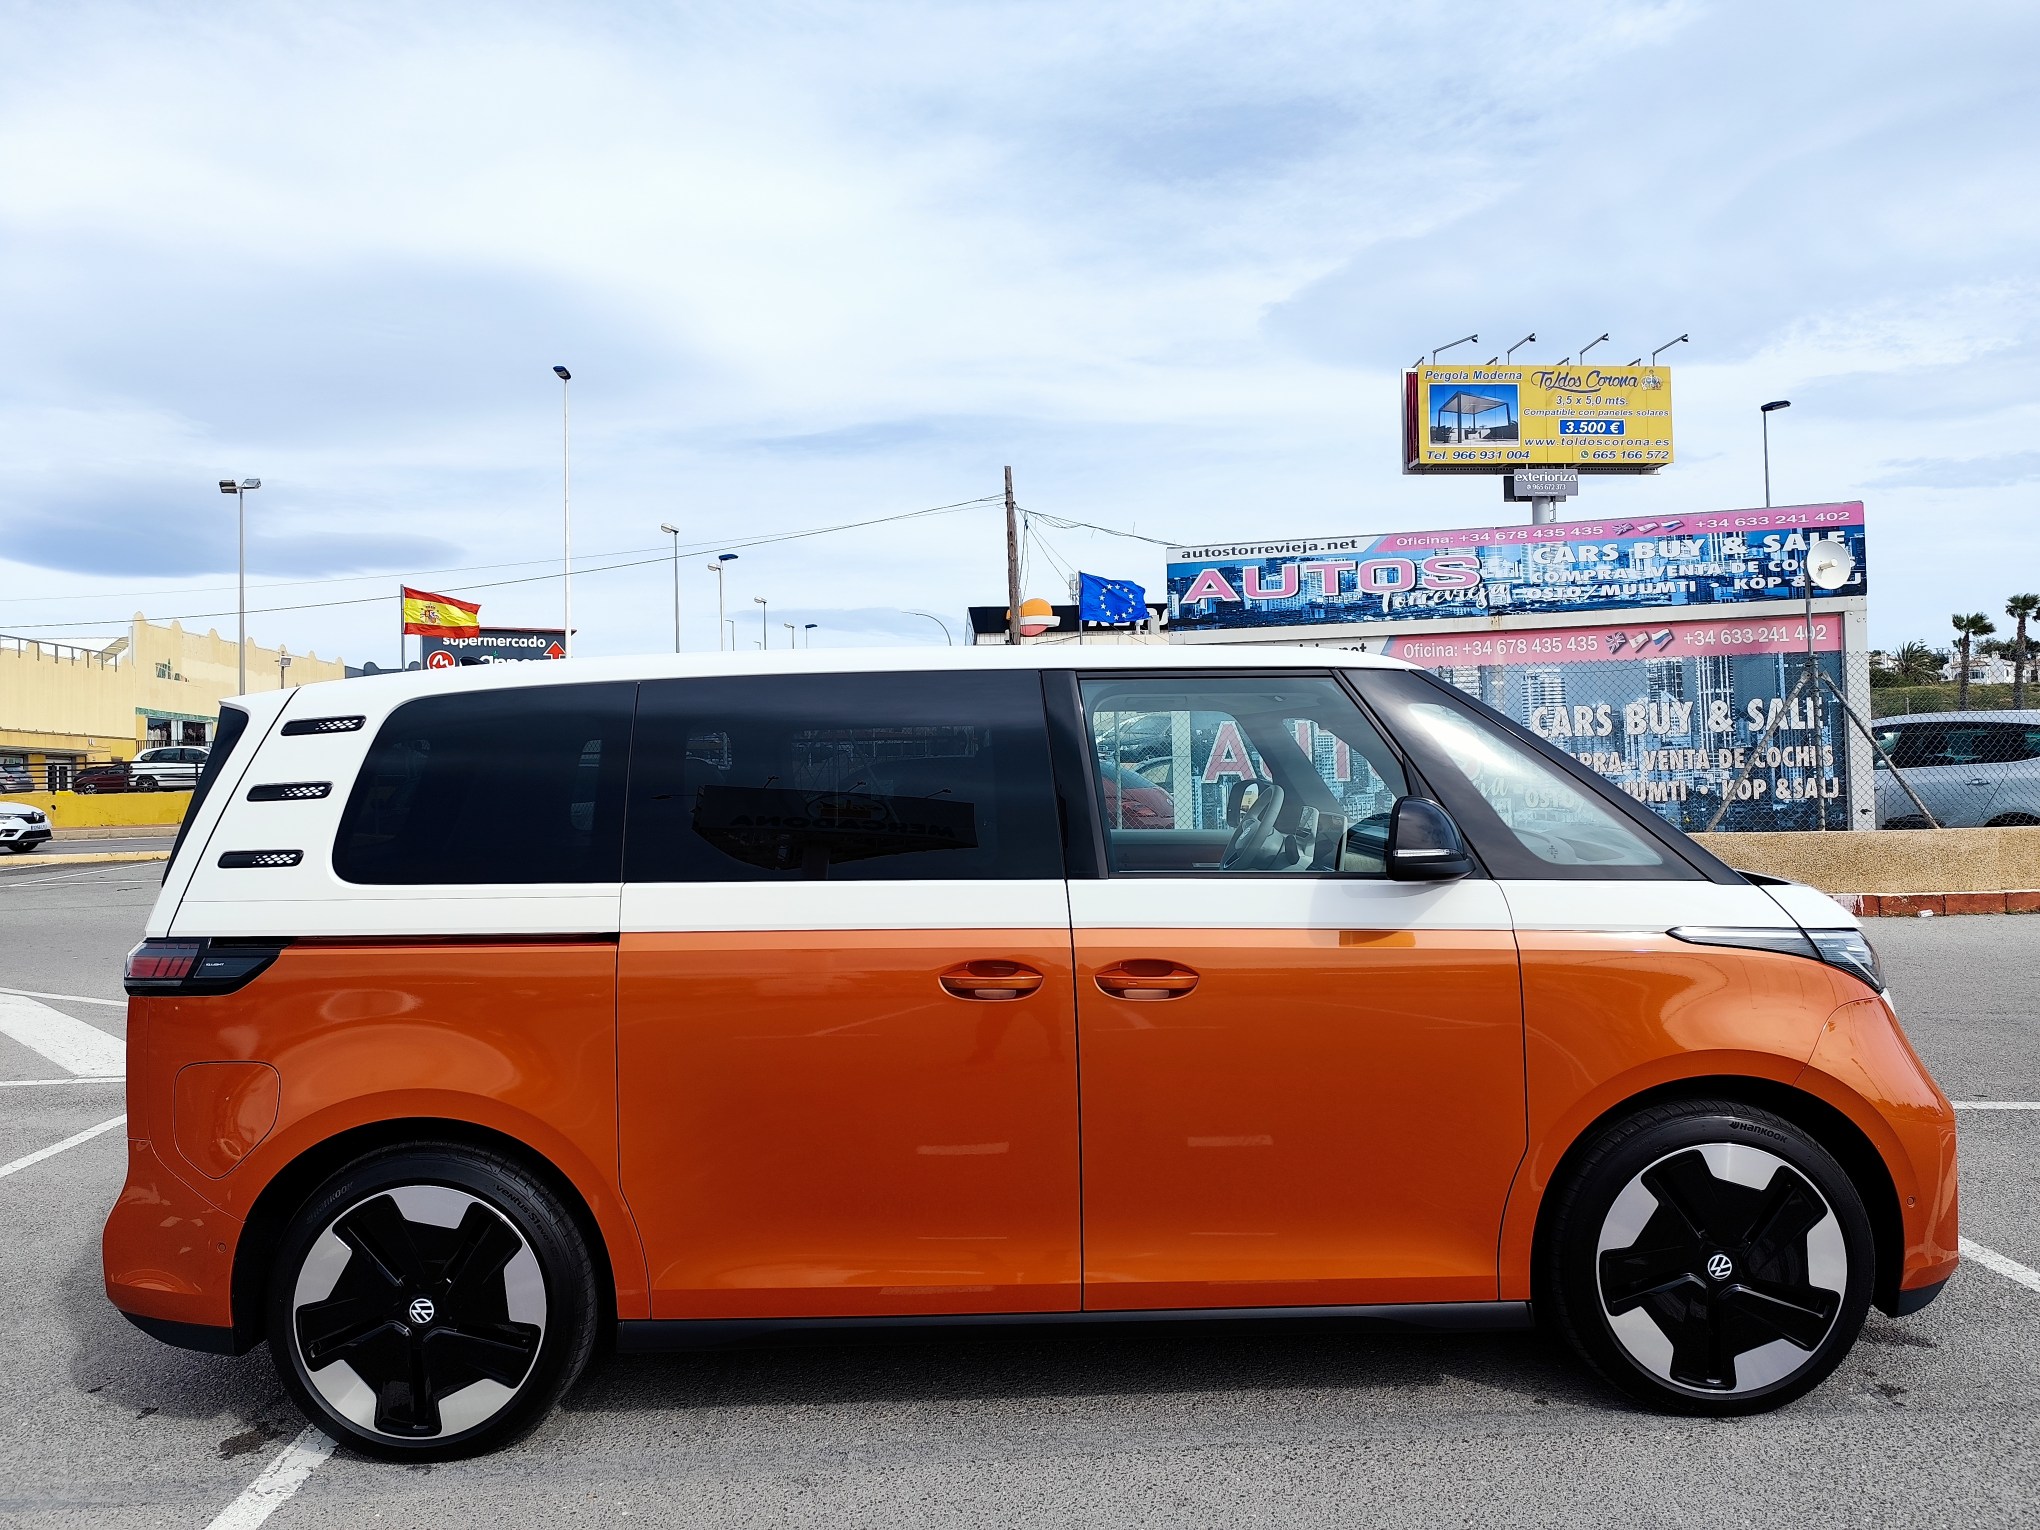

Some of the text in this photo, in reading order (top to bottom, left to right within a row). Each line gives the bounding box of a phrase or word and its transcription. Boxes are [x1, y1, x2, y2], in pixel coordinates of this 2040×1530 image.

[1425, 370, 1522, 381] Pérgola Moderna
[1531, 370, 1639, 391] Toldos Corona
[1556, 395, 1573, 406] 3,5
[1585, 395, 1602, 406] 5,0
[1605, 396, 1628, 405] mts.
[1524, 408, 1576, 417] Compatible
[1598, 409, 1633, 418] paneles
[1565, 422, 1620, 433] 3.500 €
[1524, 437, 1669, 446] www.toldoscorona.es
[1426, 450, 1530, 460] Tel. 966 931 004
[1593, 450, 1669, 459] 665 166 572
[1515, 471, 1577, 482] exterioriza
[1695, 511, 1850, 529] +34 633 241 402
[1396, 526, 1604, 547] Oficina: +34 678 435 435
[1181, 539, 1358, 559] autostorrevieja.net
[1532, 543, 1619, 564] CARS
[1633, 538, 1706, 559] BUY
[1720, 536, 1749, 554] &
[1651, 561, 1723, 578] VENTA
[1731, 560, 1759, 573] DE
[1180, 555, 1483, 604] AUTOS
[442, 635, 546, 649] supermercado
[1684, 624, 1827, 646] +34 633 241 402
[1403, 635, 1598, 659] Oficina: +34 678 435 435
[1530, 704, 1614, 738] CARS
[1624, 701, 1694, 736] BUY
[1708, 700, 1735, 732] &
[1643, 749, 1711, 771] VENTA
[1718, 748, 1745, 769] DE
